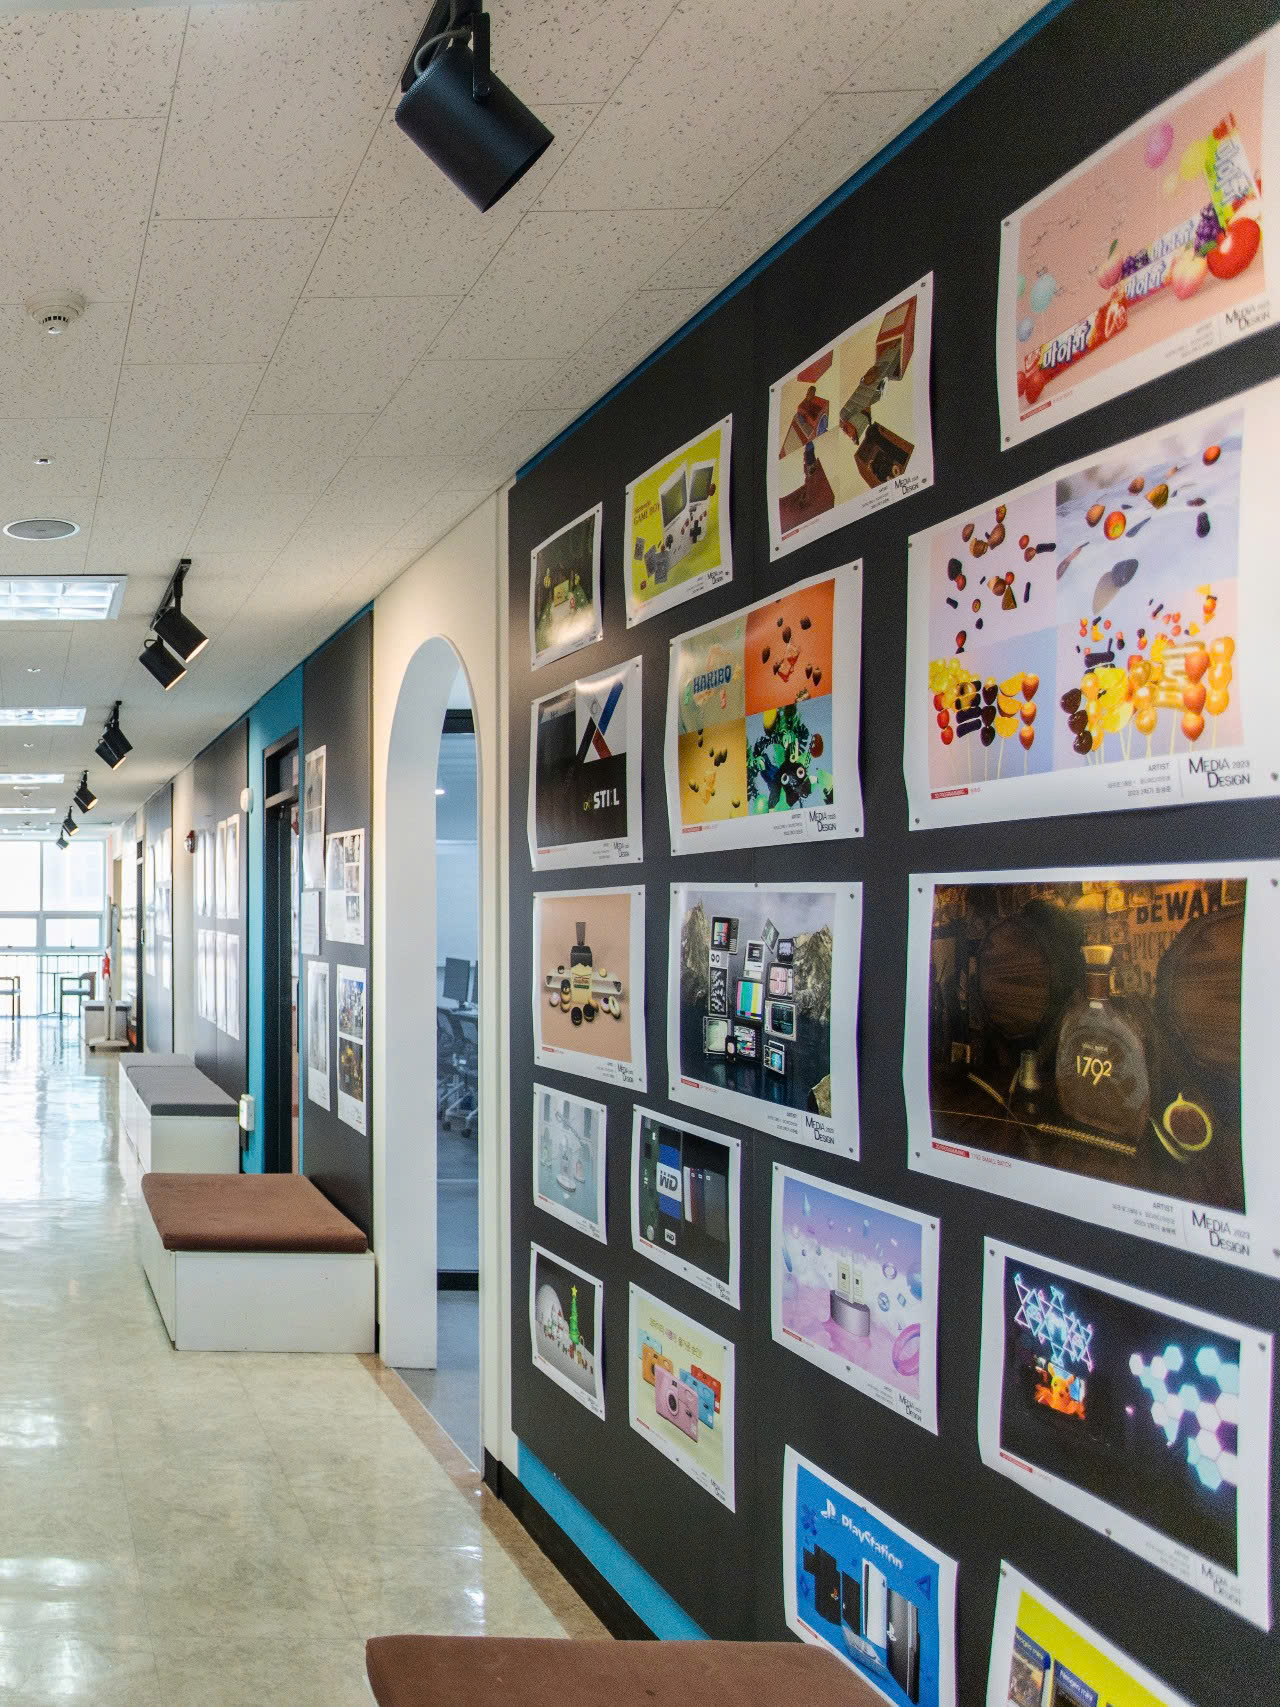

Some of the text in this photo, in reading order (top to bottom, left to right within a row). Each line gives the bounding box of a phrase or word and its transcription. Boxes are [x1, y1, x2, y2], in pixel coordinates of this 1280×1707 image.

[693, 664, 732, 693] HARIBO
[1148, 763, 1169, 772] ARTIST
[1189, 756, 1230, 775] MEDIA
[1207, 771, 1250, 789] DESIGN
[809, 810, 827, 823] MEDIA
[817, 820, 837, 832] DESIGN
[1076, 1055, 1112, 1086] 1792
[805, 1115, 825, 1131] MEDIA
[814, 1129, 835, 1145] DESIGN
[1152, 1202, 1174, 1212] ARTIST
[1191, 1209, 1231, 1234] MEDIA
[1209, 1229, 1250, 1256] DESIGN
[841, 1513, 904, 1571] PlayStation
